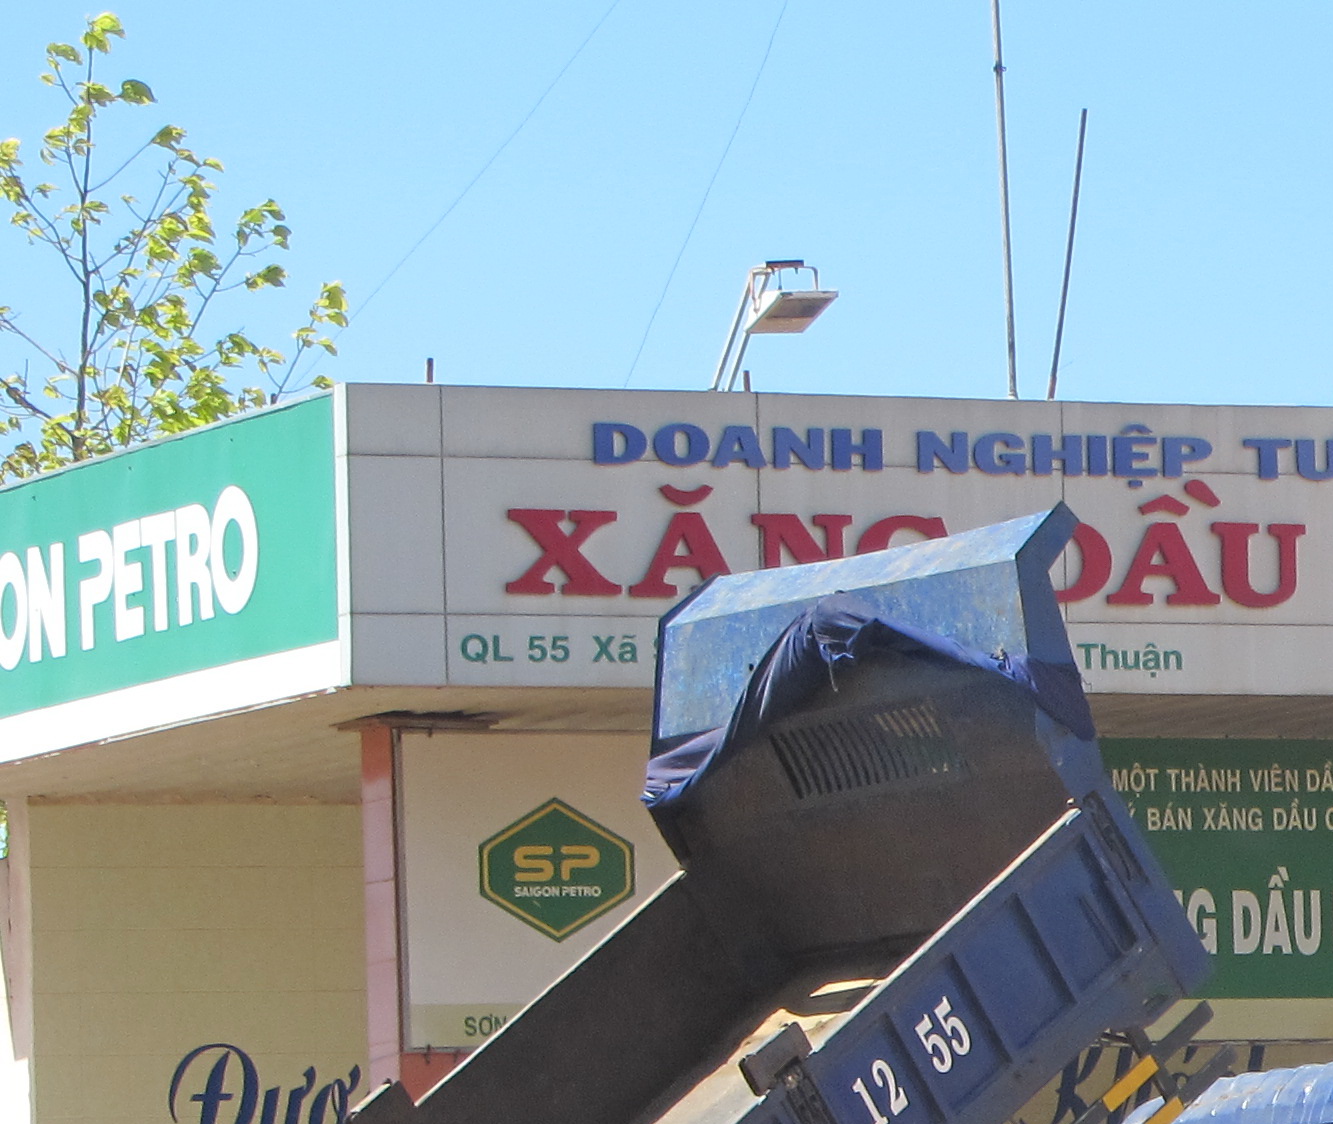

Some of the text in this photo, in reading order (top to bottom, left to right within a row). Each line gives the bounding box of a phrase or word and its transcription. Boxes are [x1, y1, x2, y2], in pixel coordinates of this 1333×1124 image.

[592, 421, 883, 473] DOANH
[917, 423, 1214, 488] NGHIỆP
[79, 485, 258, 650] PETRO
[460, 633, 513, 664] QL
[528, 635, 570, 663] 55
[592, 634, 638, 663] Xã
[1076, 643, 1183, 678] Thuận
[1112, 762, 1158, 797] MỘT
[1167, 763, 1241, 792] THÀNH
[1250, 762, 1299, 792] VIÊN
[1147, 802, 1192, 831] BÁN
[1202, 803, 1263, 831] XĂNG
[1272, 798, 1317, 831] DẦU
[514, 845, 598, 883] SP
[514, 886, 602, 897] SAIGON PETRO
[1232, 868, 1321, 955] DẦU
[915, 995, 974, 1074] 55
